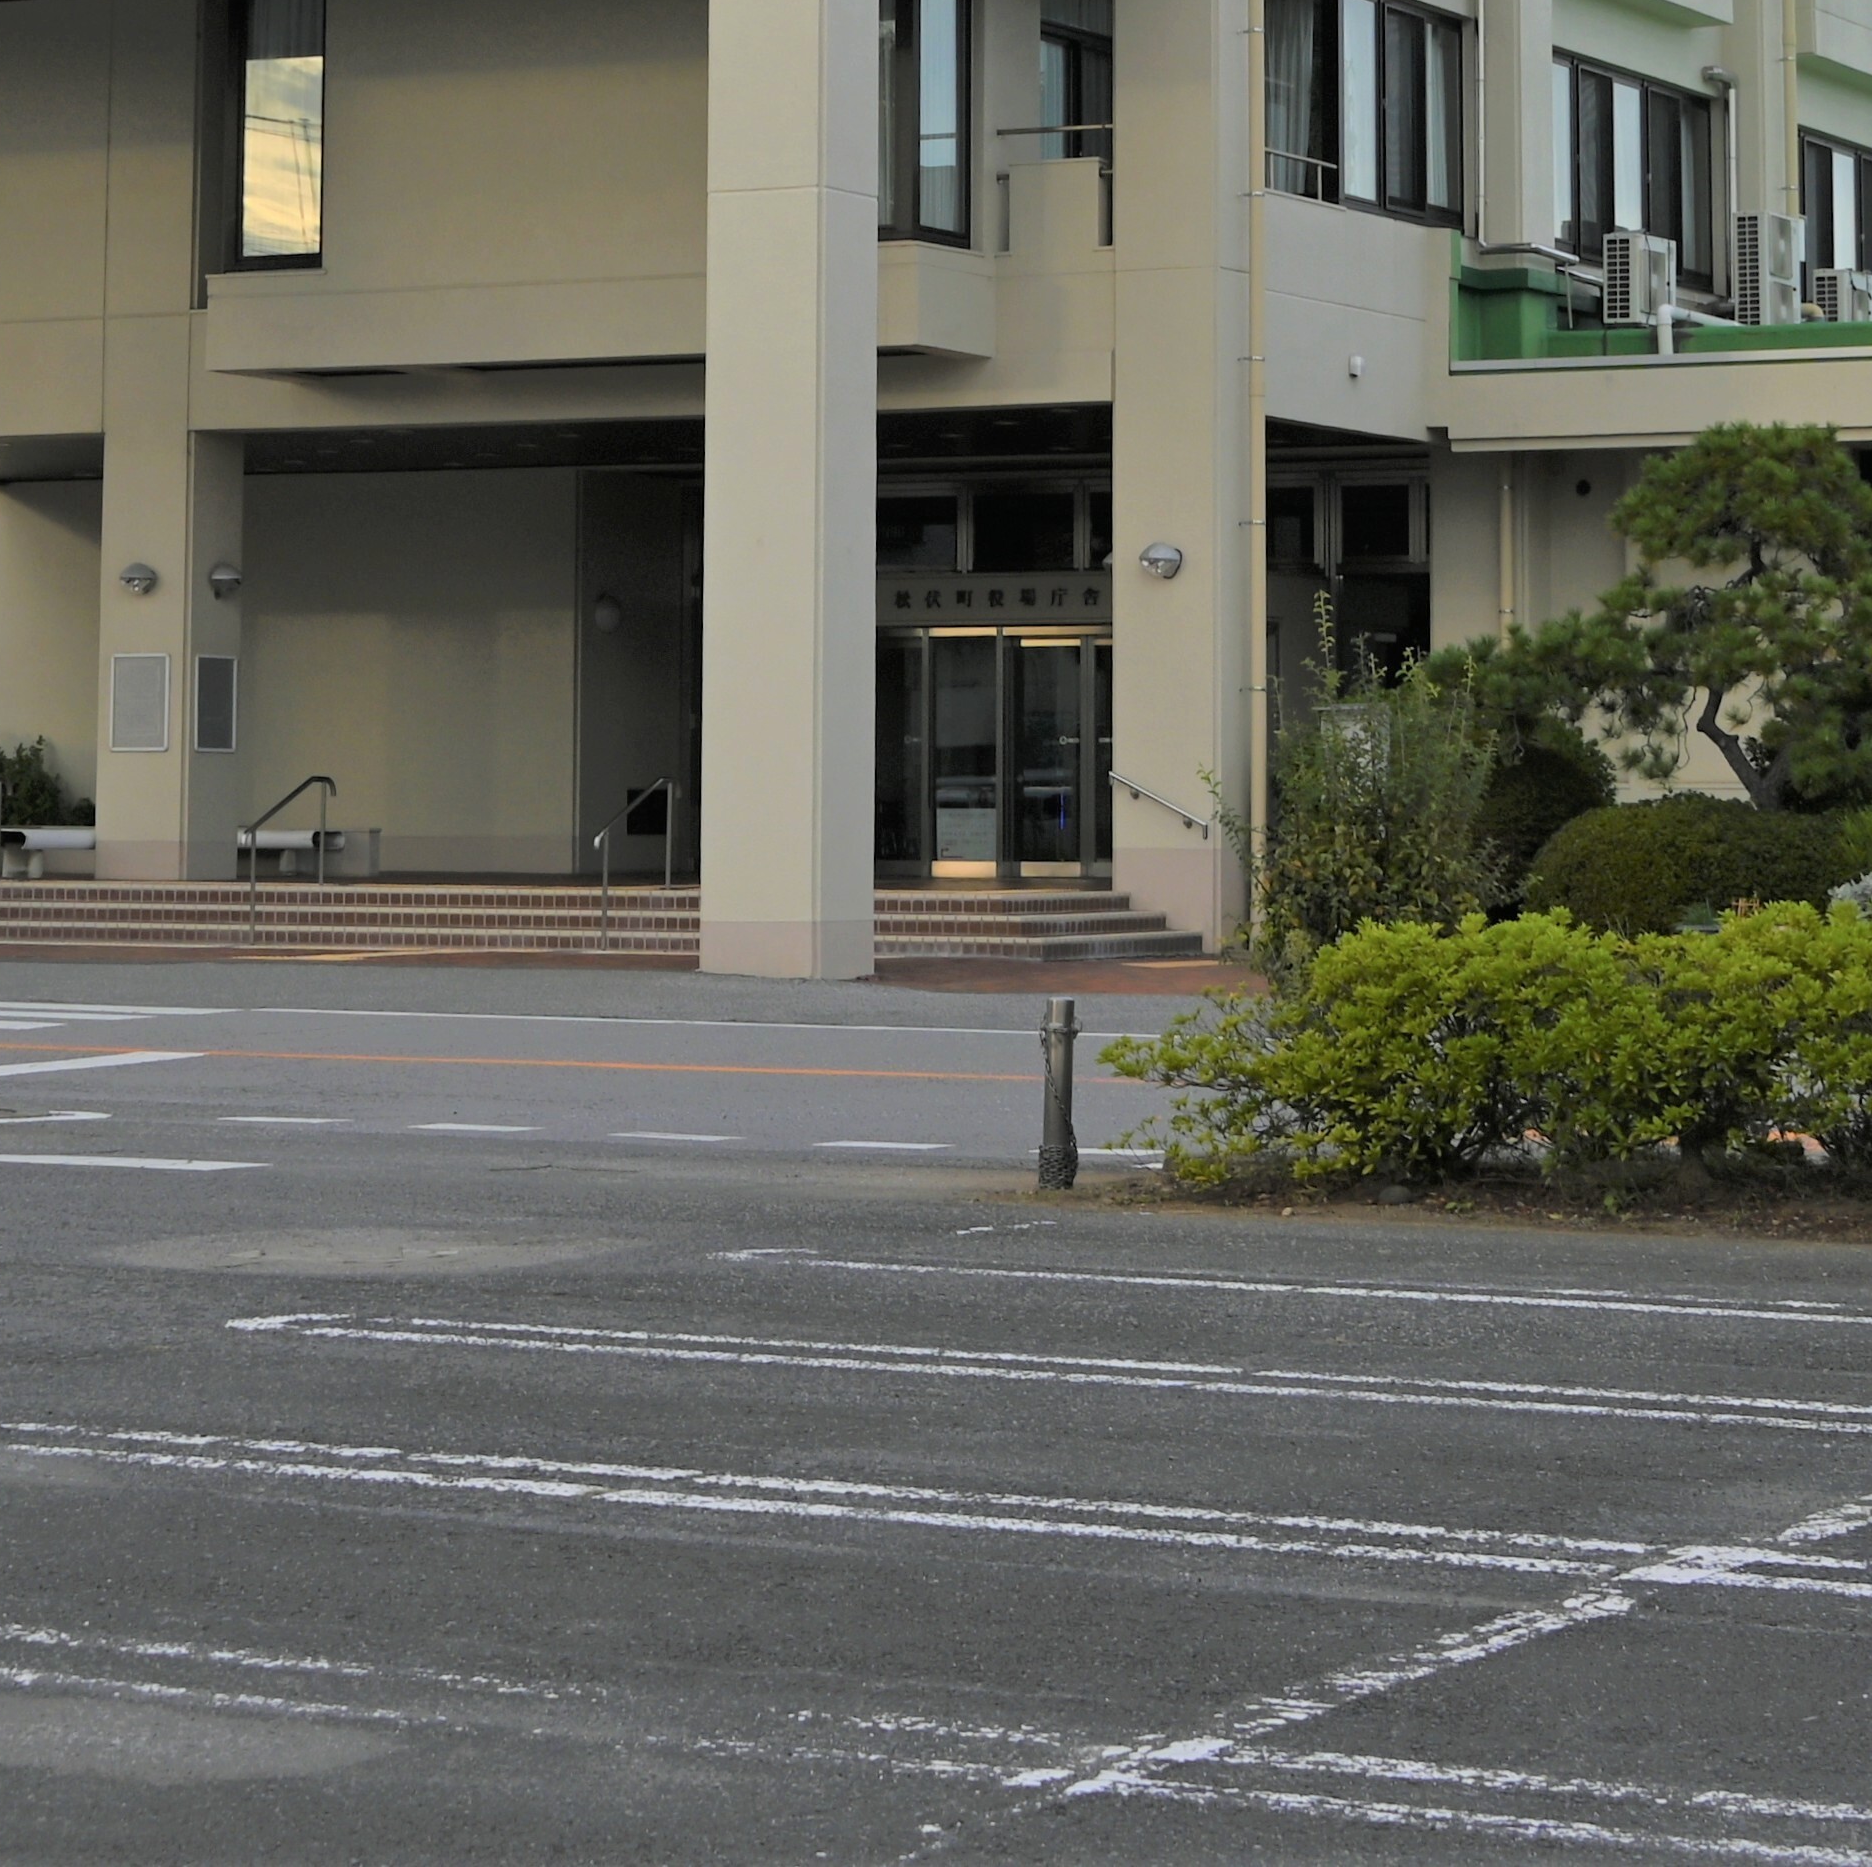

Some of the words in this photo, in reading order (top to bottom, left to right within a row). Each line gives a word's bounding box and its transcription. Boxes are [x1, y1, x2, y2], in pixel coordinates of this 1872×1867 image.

[894, 588, 1101, 609] 松伏町役場庁舎
